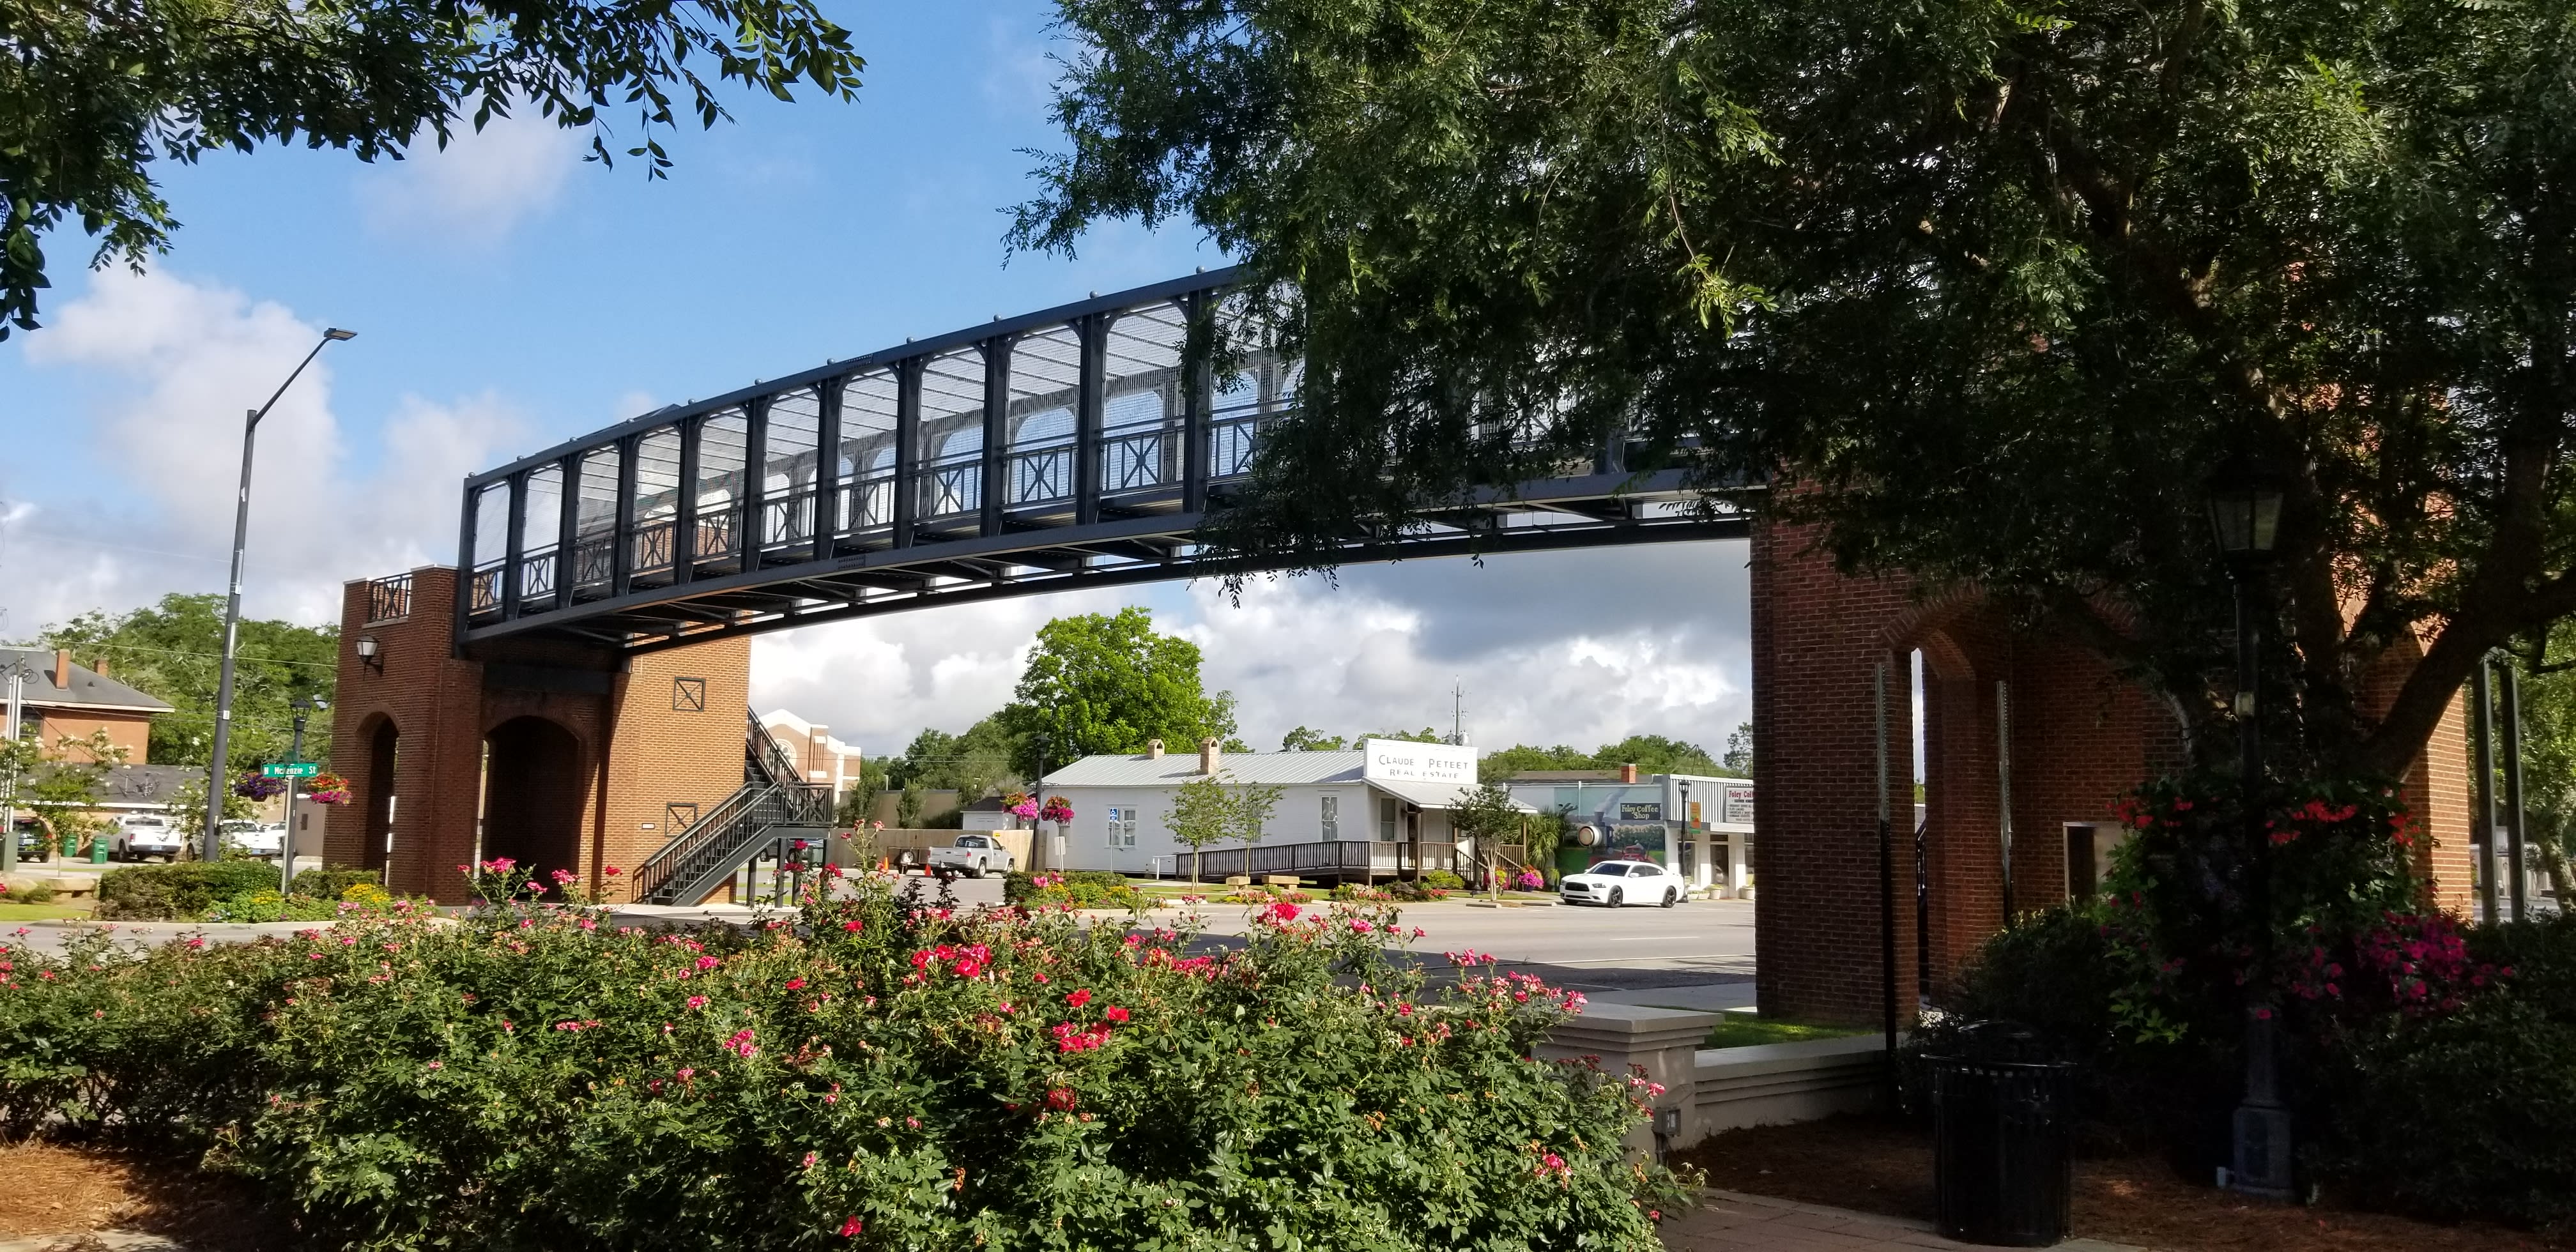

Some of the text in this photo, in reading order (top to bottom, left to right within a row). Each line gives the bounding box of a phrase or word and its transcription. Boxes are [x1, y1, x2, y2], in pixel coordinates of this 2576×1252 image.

[1379, 754, 1468, 770] CLAUDE PETEET
[264, 767, 269, 775] N
[309, 766, 317, 774] St
[1729, 790, 1741, 799] Foley
[1621, 804, 1659, 814] Foley Coffee
[1633, 812, 1650, 820] Shop
